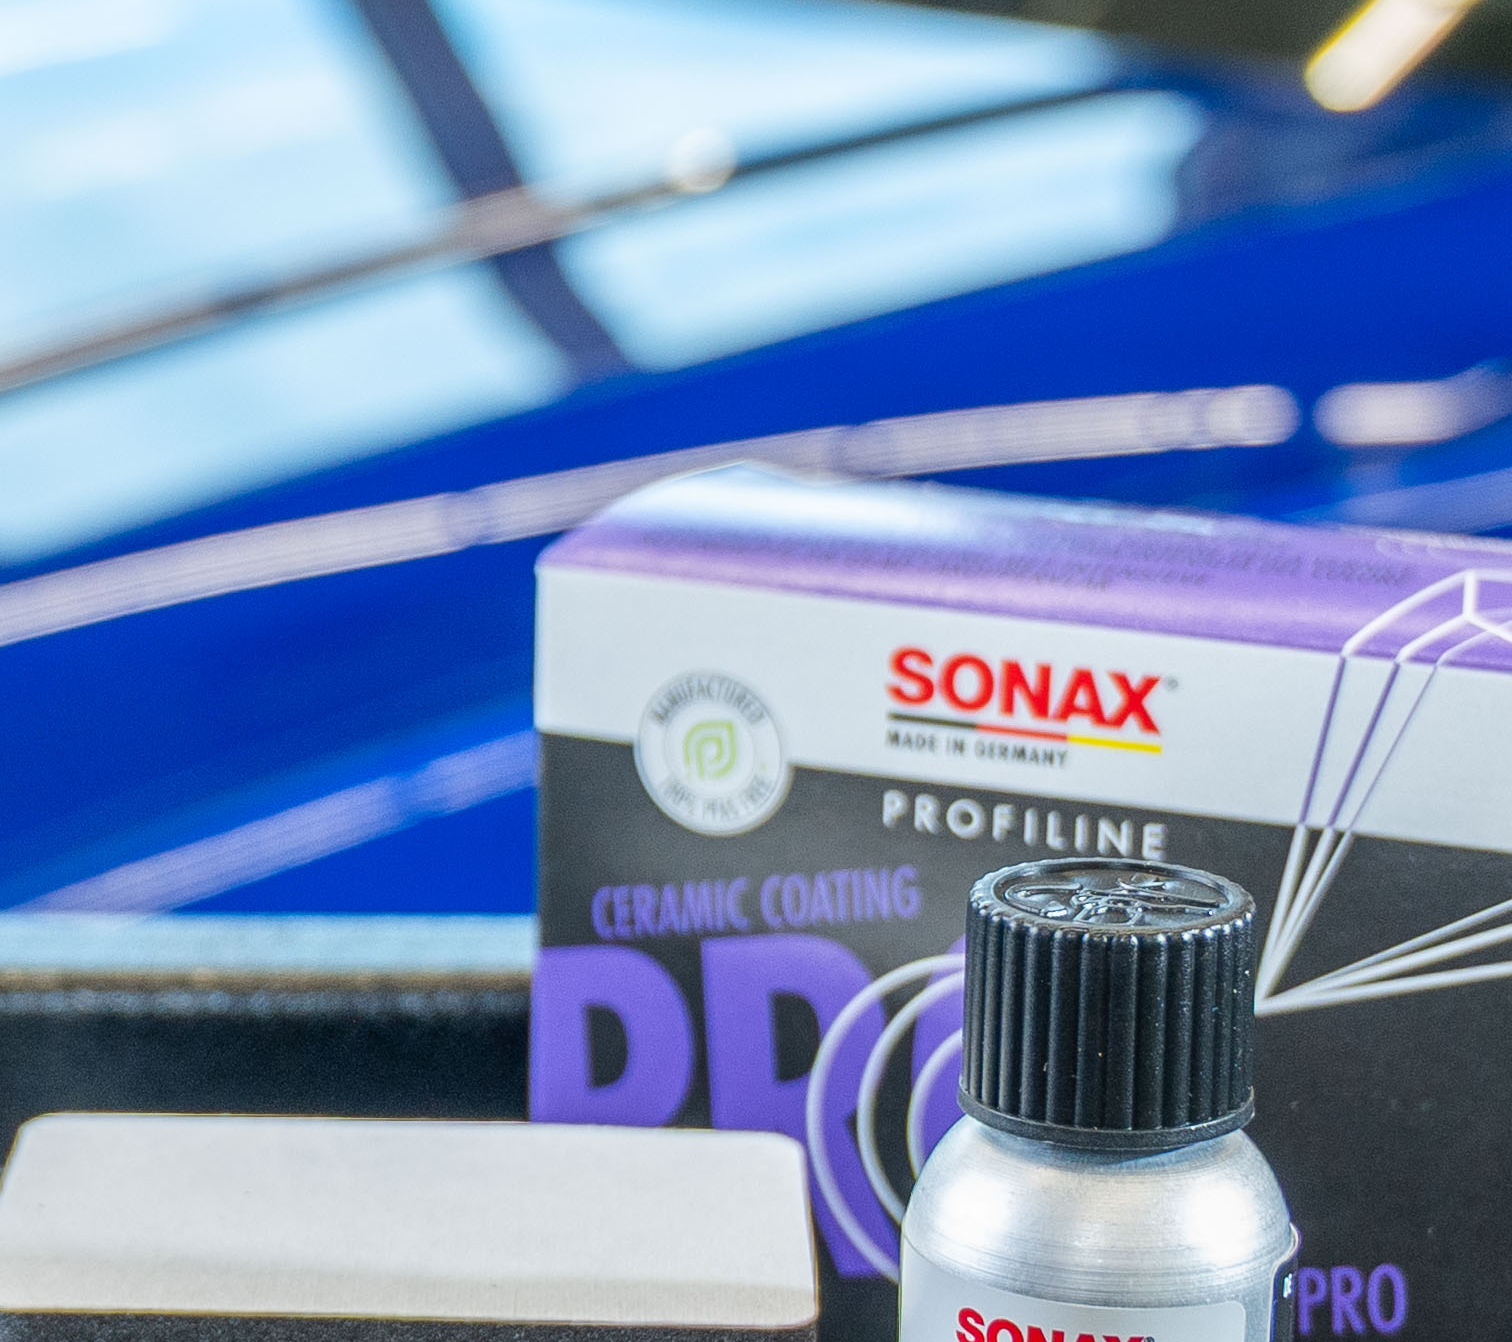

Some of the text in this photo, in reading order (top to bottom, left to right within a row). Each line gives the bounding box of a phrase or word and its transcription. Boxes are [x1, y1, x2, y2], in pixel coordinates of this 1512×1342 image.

[885, 728, 1070, 768] MADE IN GERMANY
[881, 788, 1169, 862] PROFILINE
[590, 864, 924, 941] CERAMIC COATING
[1297, 1262, 1409, 1336] PRO
